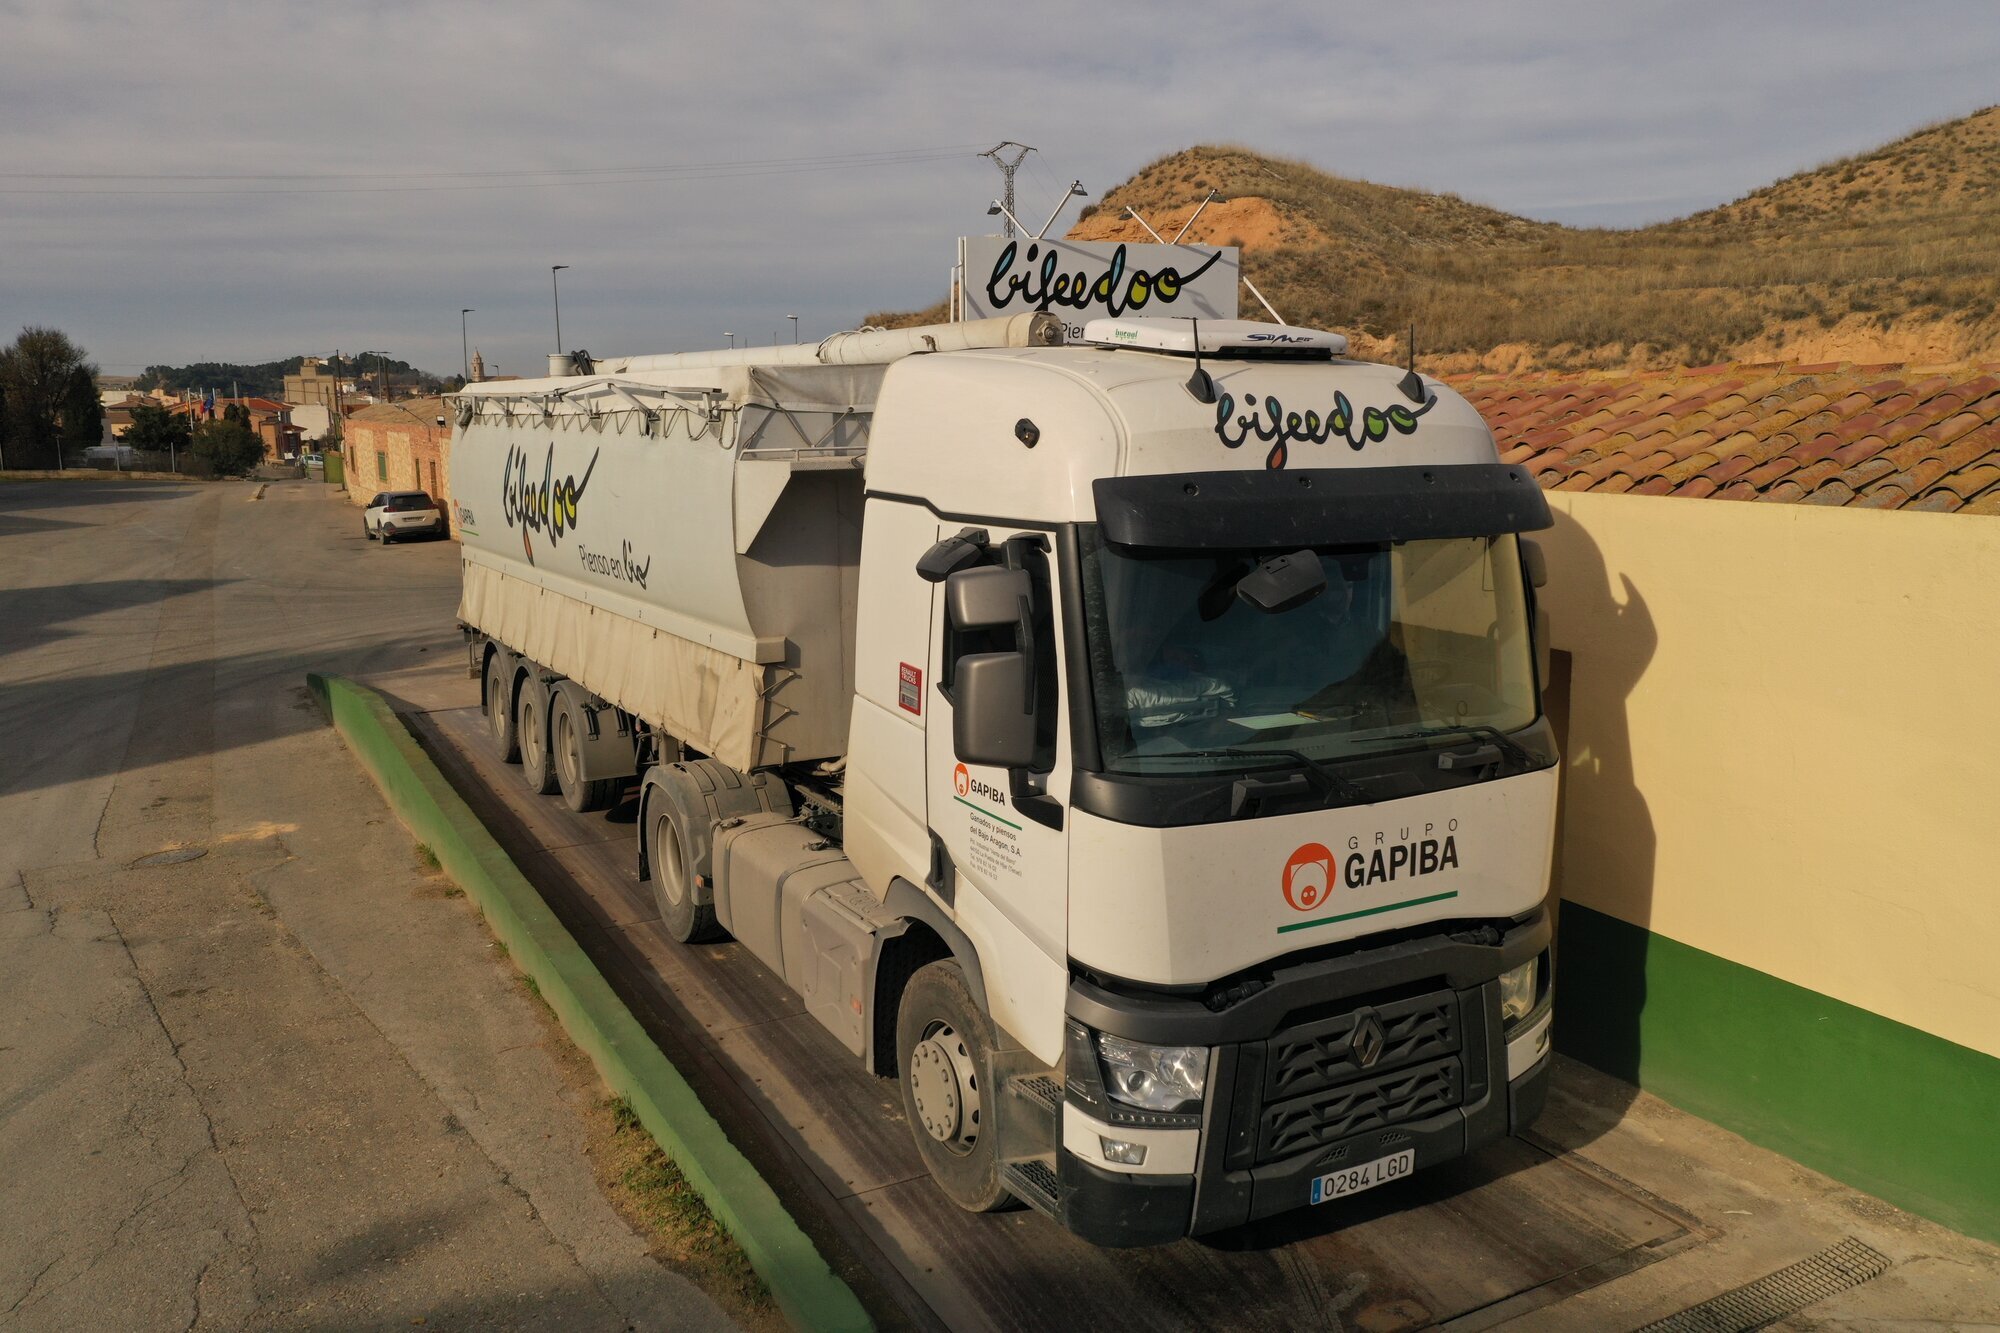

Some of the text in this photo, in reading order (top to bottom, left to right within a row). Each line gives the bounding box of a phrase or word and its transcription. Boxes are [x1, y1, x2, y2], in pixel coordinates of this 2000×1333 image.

[986, 240, 1222, 318] bifeedoo
[1215, 390, 1438, 471] bifeedoo
[503, 441, 599, 567] bifeedoo
[578, 544, 611, 577] Pienso
[611, 558, 625, 581] en
[970, 778, 1006, 806] GAPIBA
[969, 812, 991, 828] Ganados
[996, 826, 1017, 841] piensos
[969, 826, 977, 835] del
[1348, 818, 1458, 850] GRUPO
[1344, 835, 1459, 889] GAPIBA
[1324, 1155, 1409, 1197] 0284 LGD
